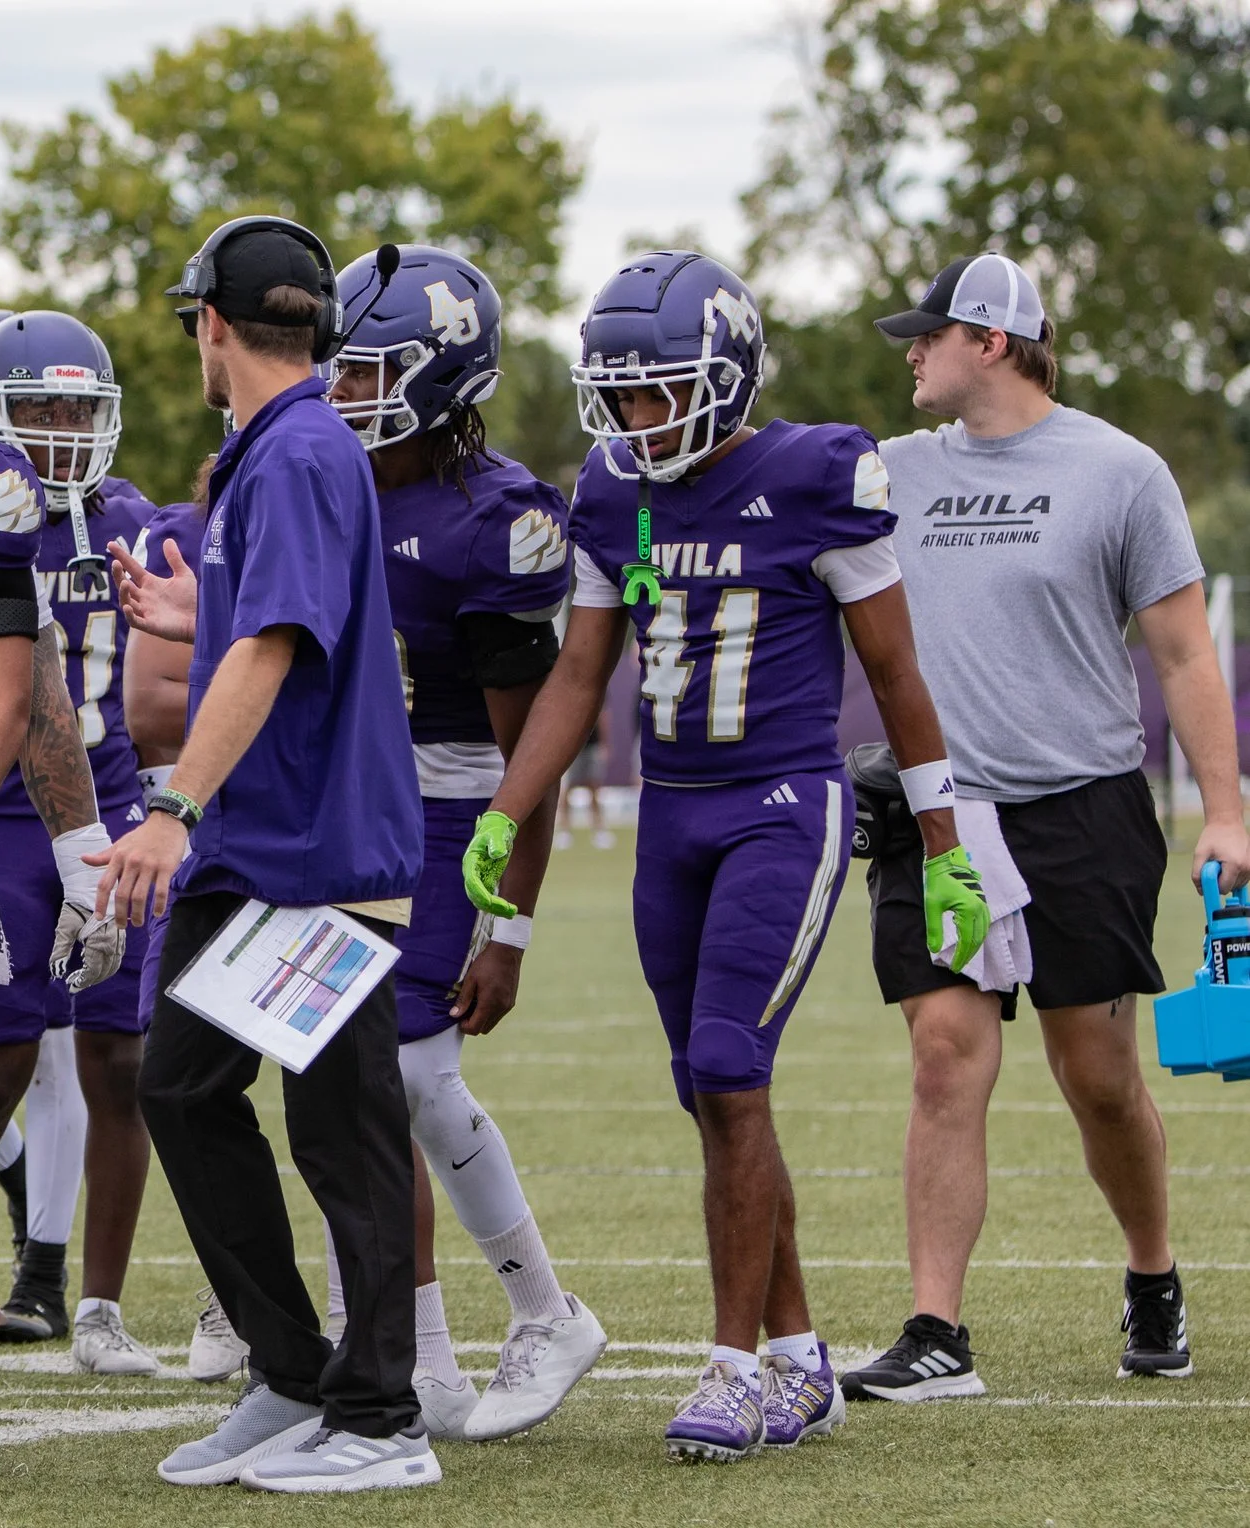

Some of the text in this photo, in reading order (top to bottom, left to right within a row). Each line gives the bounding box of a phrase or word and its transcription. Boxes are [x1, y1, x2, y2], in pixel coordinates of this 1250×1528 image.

[969, 310, 990, 319] adidas
[606, 356, 625, 365] schutt
[56, 368, 85, 378] Riddell
[923, 495, 1050, 516] AVILA
[76, 515, 87, 551] BATTLE
[640, 513, 649, 555] BATTLE
[920, 532, 977, 548] ATHLETIC
[980, 530, 1041, 546] TRAINING
[641, 588, 760, 742] 41
